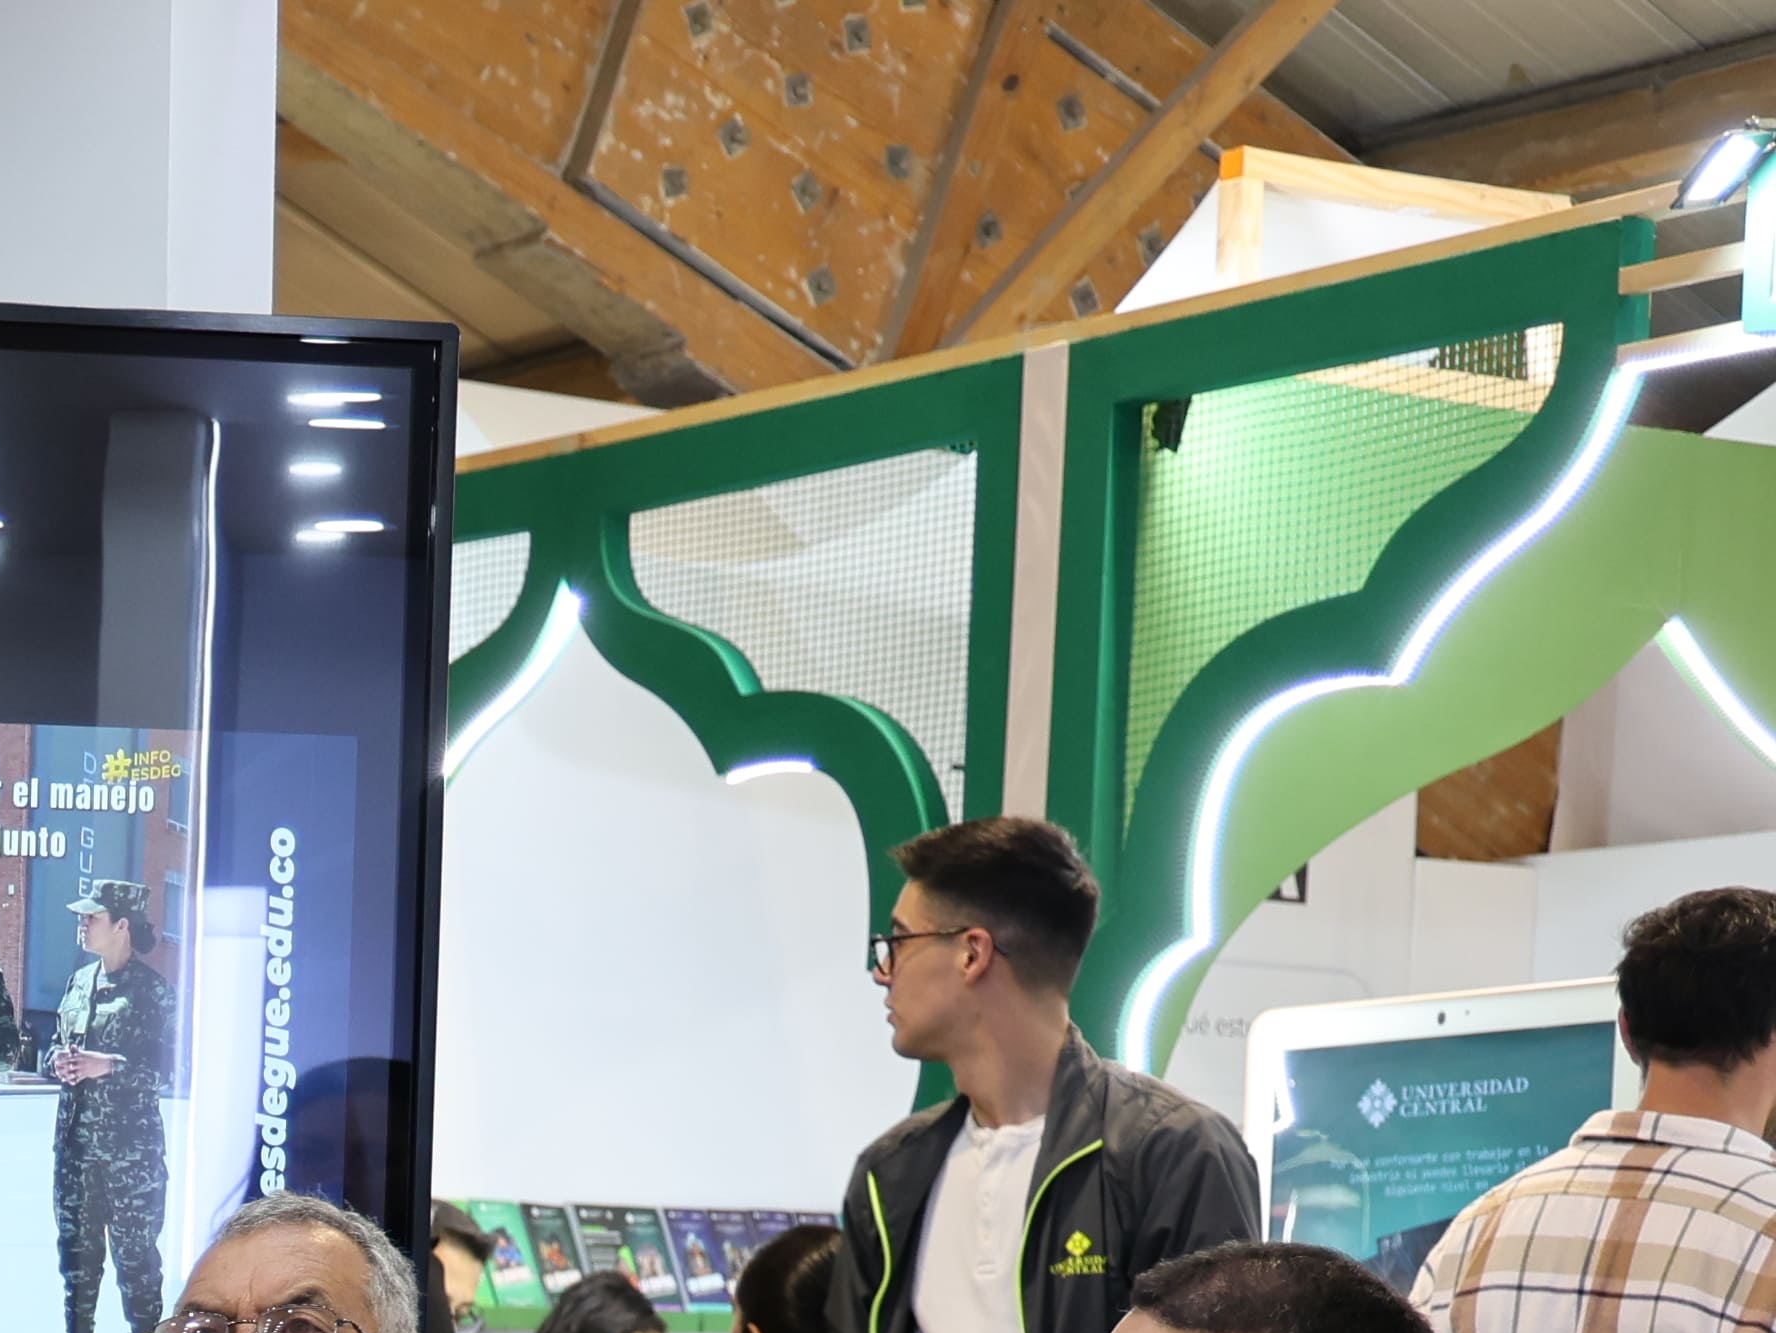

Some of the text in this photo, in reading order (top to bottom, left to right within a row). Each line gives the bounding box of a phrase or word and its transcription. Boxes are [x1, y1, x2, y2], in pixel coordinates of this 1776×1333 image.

[134, 750, 172, 765] INFO
[130, 764, 182, 782] ESDEG
[13, 777, 38, 808] el
[49, 780, 155, 814] manejo
[1401, 1076, 1530, 1100] UNIVERSIDAD
[1400, 1097, 1488, 1118] CENTRAL
[1466, 1146, 1514, 1163] trabajar
